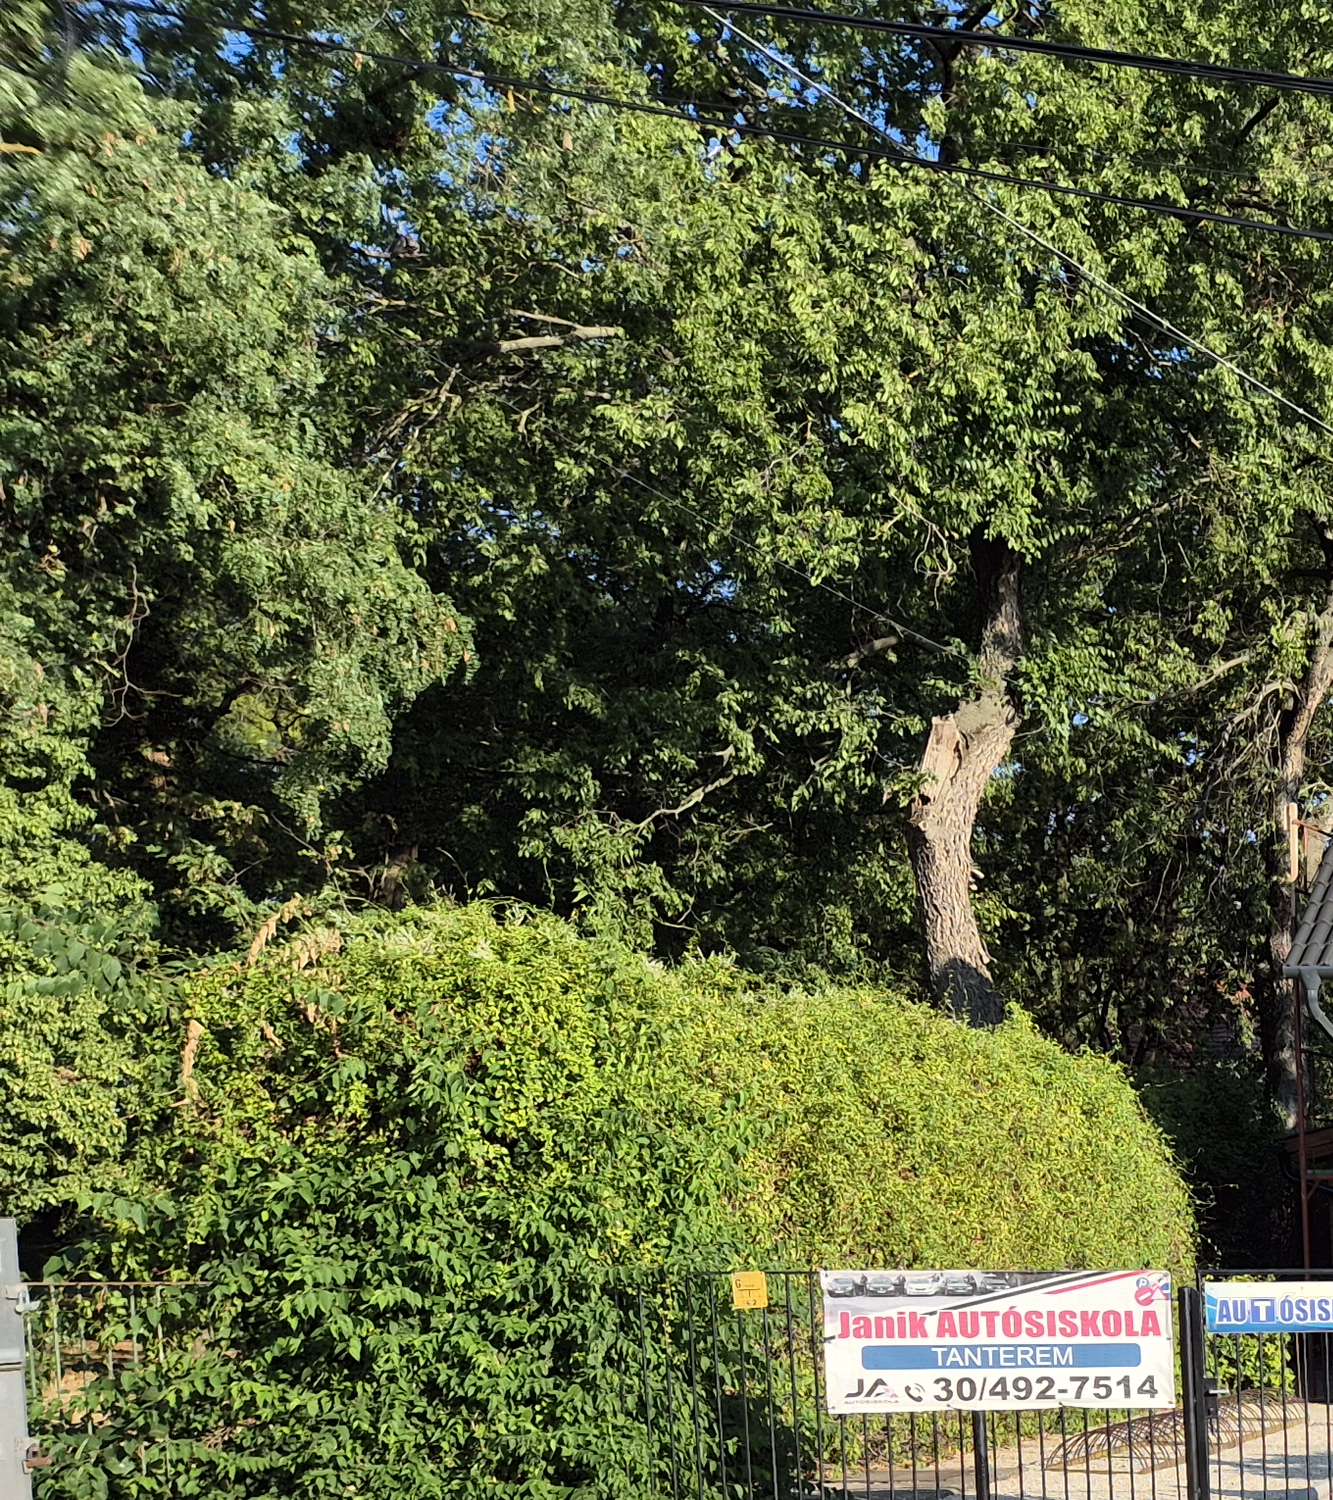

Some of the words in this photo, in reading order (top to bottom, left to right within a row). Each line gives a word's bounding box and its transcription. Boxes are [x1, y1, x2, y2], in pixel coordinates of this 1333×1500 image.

[837, 1311, 929, 1339] Janik
[936, 1305, 1162, 1339] AUTÓSISKOLA
[931, 1346, 1074, 1367] TANTEREM
[933, 1375, 1159, 1402] 30/492-7514
